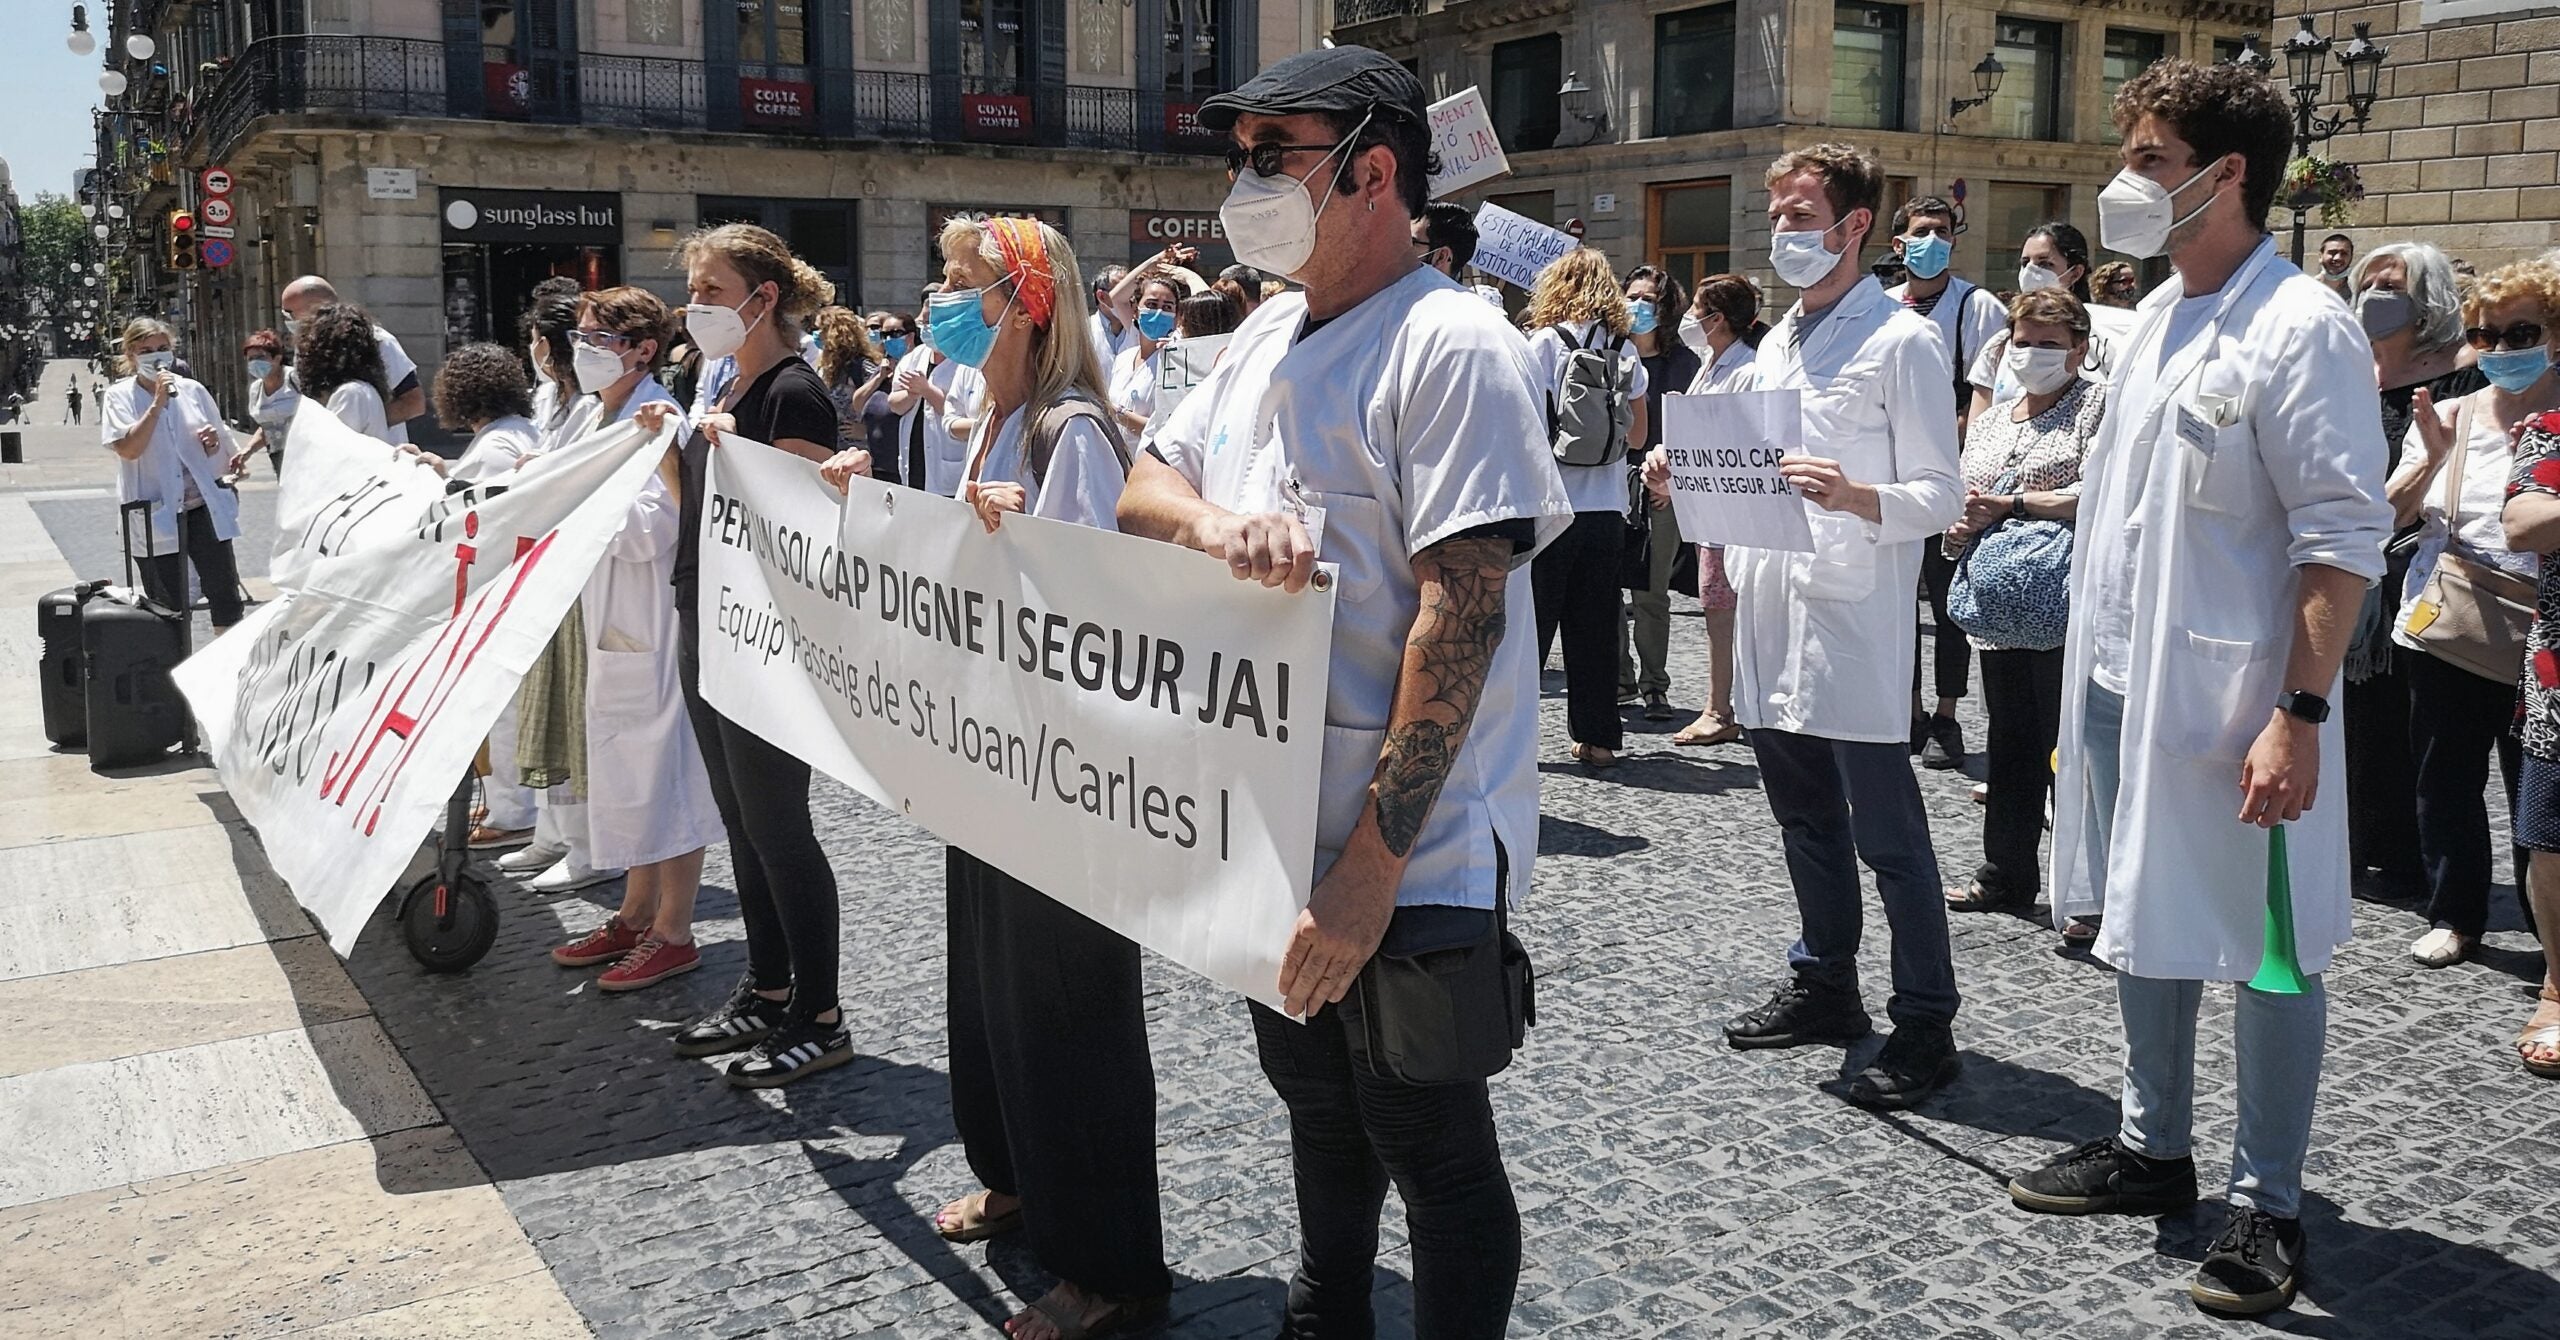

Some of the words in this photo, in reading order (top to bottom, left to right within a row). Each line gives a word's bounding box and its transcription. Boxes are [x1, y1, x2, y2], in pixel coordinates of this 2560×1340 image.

[755, 89, 799, 103] COSTA
[977, 104, 1018, 116] COSTA
[1467, 127, 1497, 162] JA!
[484, 203, 577, 230] sunglass
[580, 205, 615, 227] hut
[1147, 217, 1227, 239] COFFE
[1499, 238, 1514, 253] DE
[1665, 448, 1690, 468] PER
[1692, 448, 1715, 468] UN
[1716, 448, 1746, 468] SOL
[1749, 448, 1785, 468] CAP
[1673, 474, 1712, 493] DIGNE
[1722, 476, 1766, 495] SEGUR
[1771, 477, 1793, 496] JA!
[708, 493, 752, 552] PER
[750, 509, 777, 569] UN
[778, 525, 815, 591] SOL
[819, 544, 870, 610] CAP
[879, 563, 985, 656] DIGNE
[997, 598, 1006, 663] I
[1017, 606, 1185, 716] SEGUR
[1197, 651, 1290, 744] JA!
[718, 585, 786, 666] Equip
[790, 615, 862, 719] Passeig
[867, 659, 901, 727] de
[908, 679, 940, 746] St
[948, 695, 1198, 850] Joan/Carles
[1220, 788, 1229, 862] I
